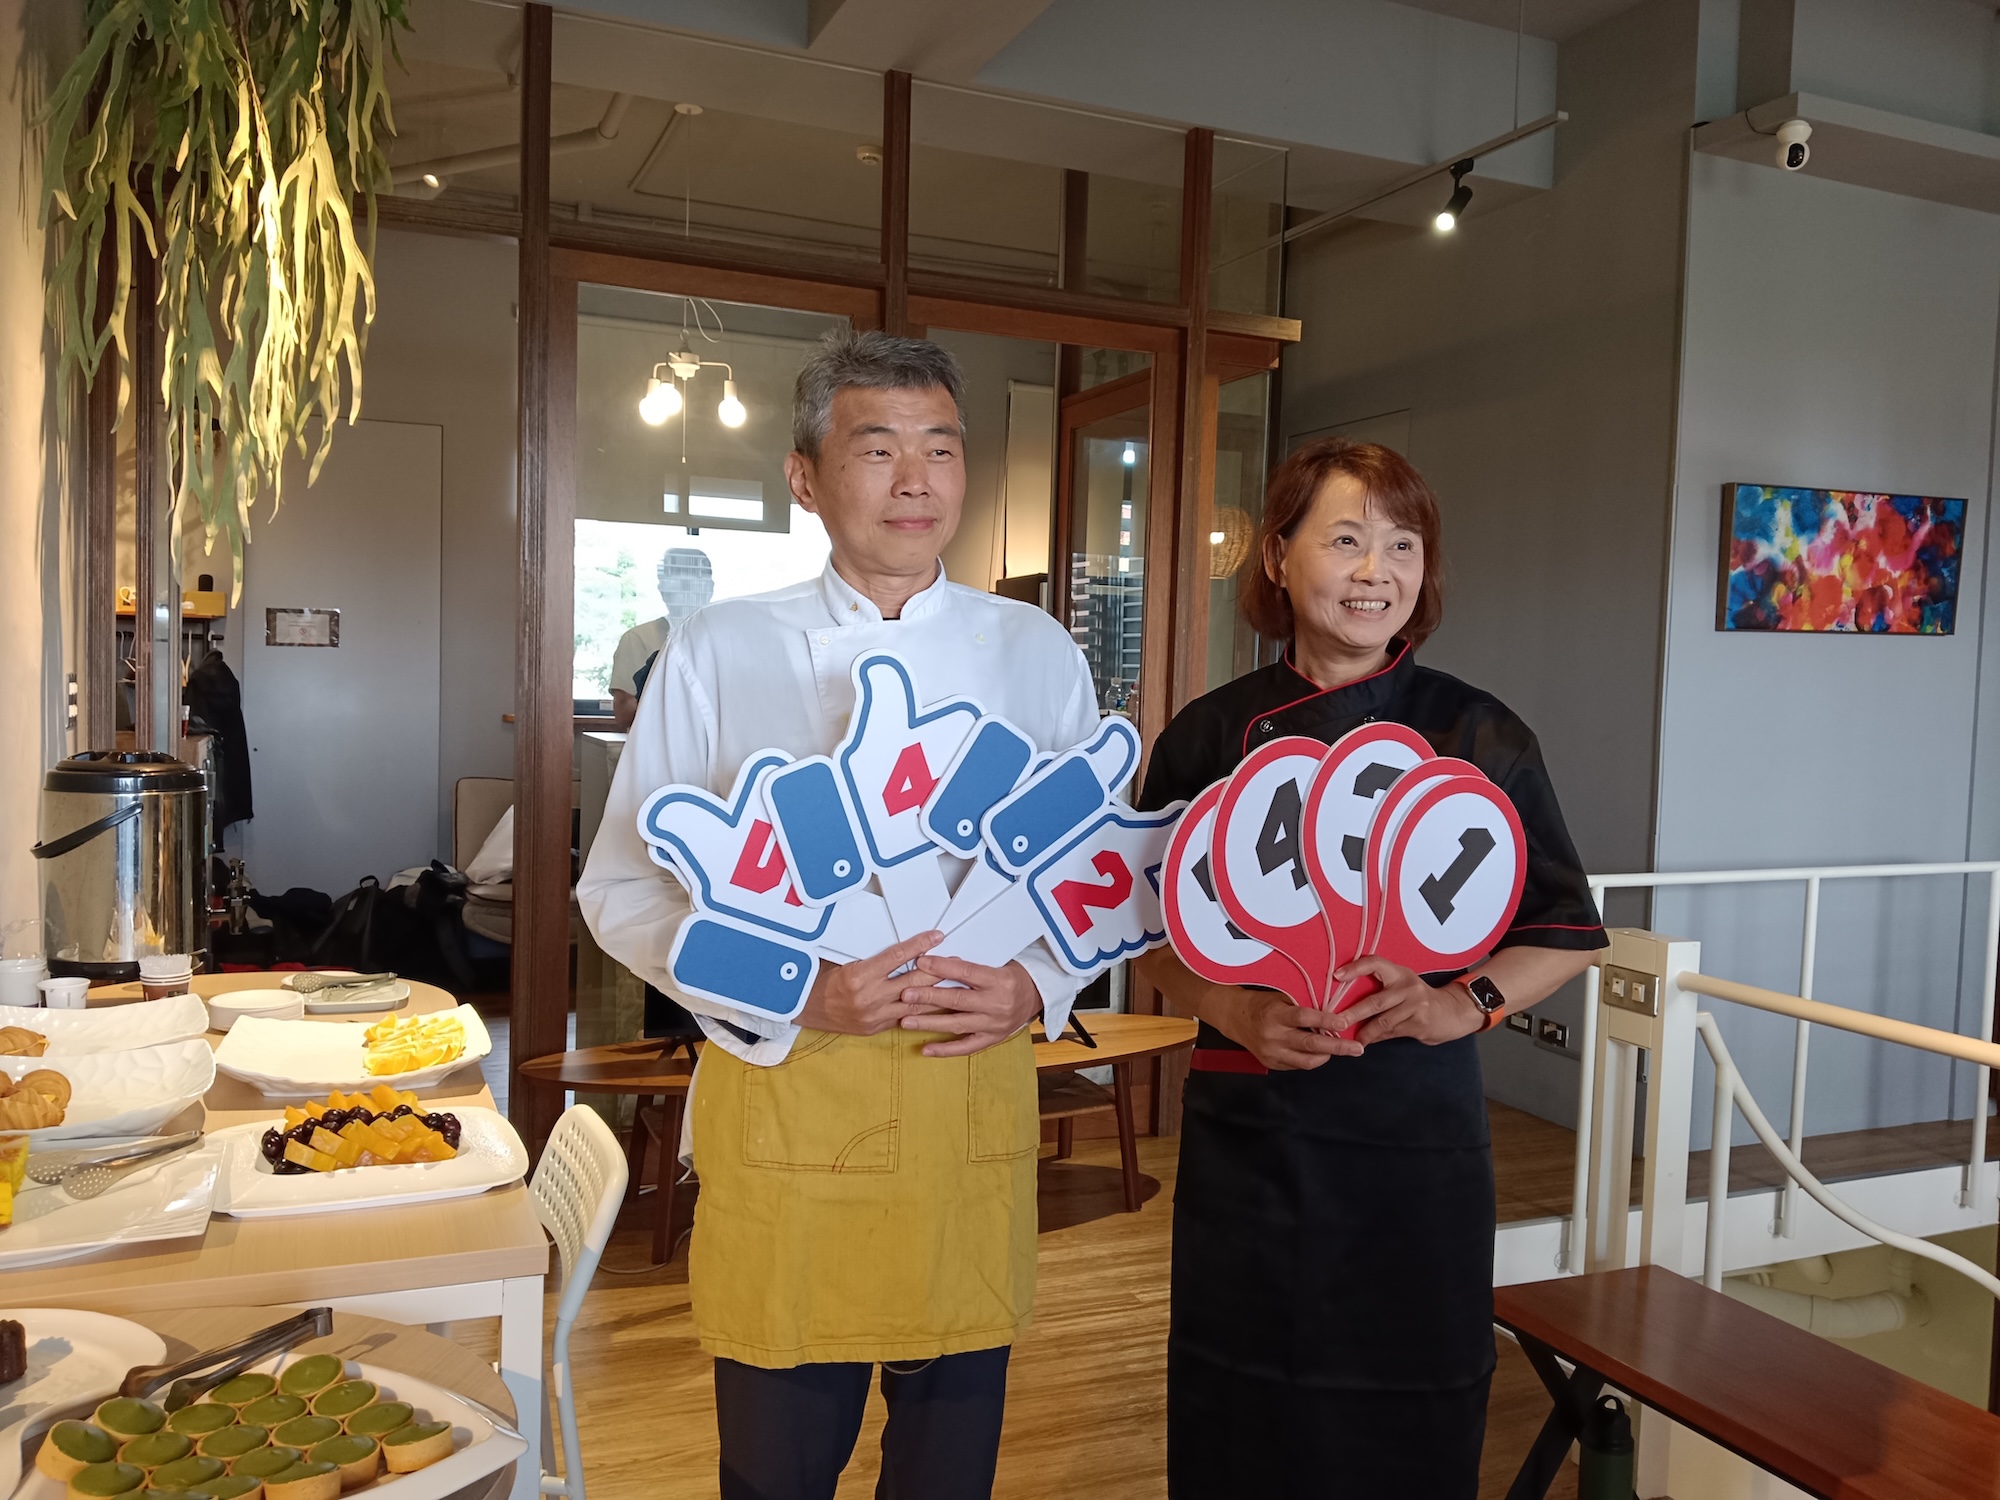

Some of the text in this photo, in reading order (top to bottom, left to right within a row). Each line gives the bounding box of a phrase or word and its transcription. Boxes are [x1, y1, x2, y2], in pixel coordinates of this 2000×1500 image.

[883, 743, 939, 817] 4
[1255, 777, 1309, 891] 4
[1418, 828, 1497, 926] 1
[1051, 849, 1134, 937] 2
